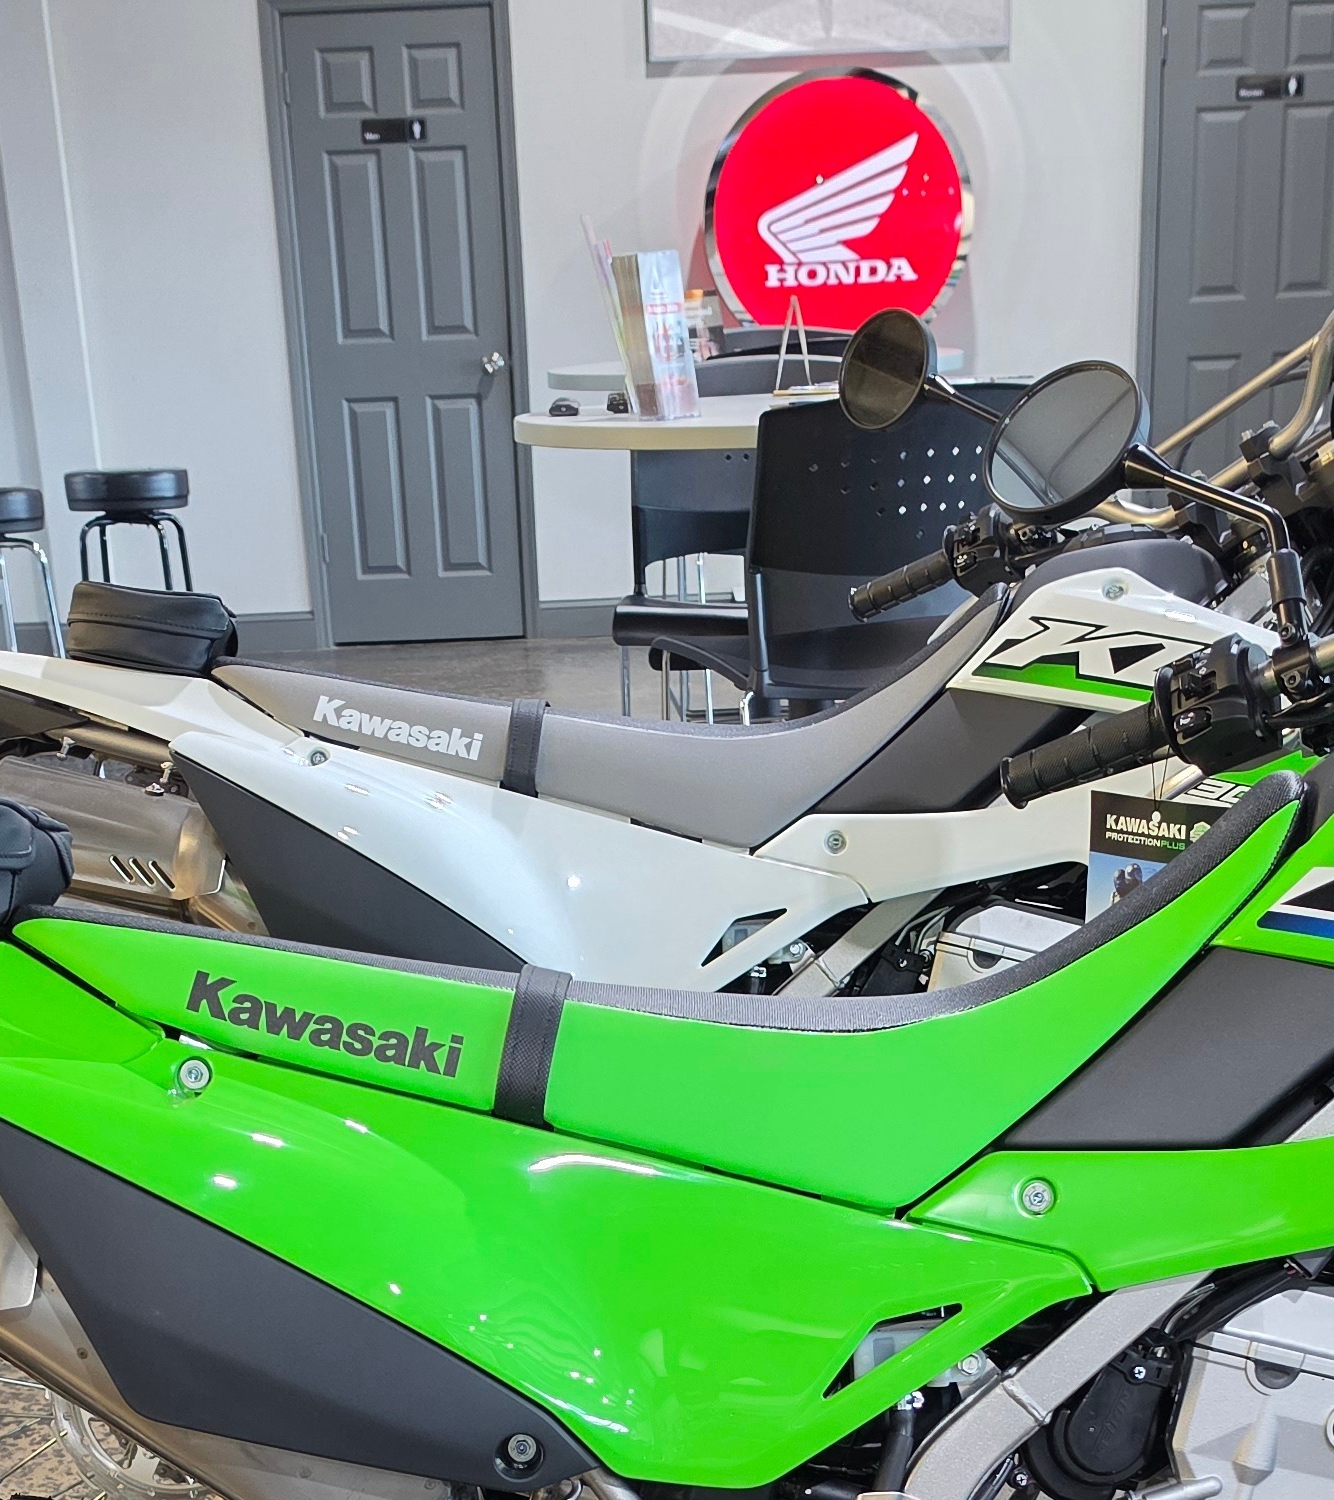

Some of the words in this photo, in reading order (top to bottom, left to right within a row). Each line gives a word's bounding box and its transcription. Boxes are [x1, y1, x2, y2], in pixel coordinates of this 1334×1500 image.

[764, 256, 919, 288] HONDA
[312, 695, 484, 761] Kawasaki
[1105, 813, 1187, 840] KAWASAKI
[185, 969, 465, 1078] Kawasaki
